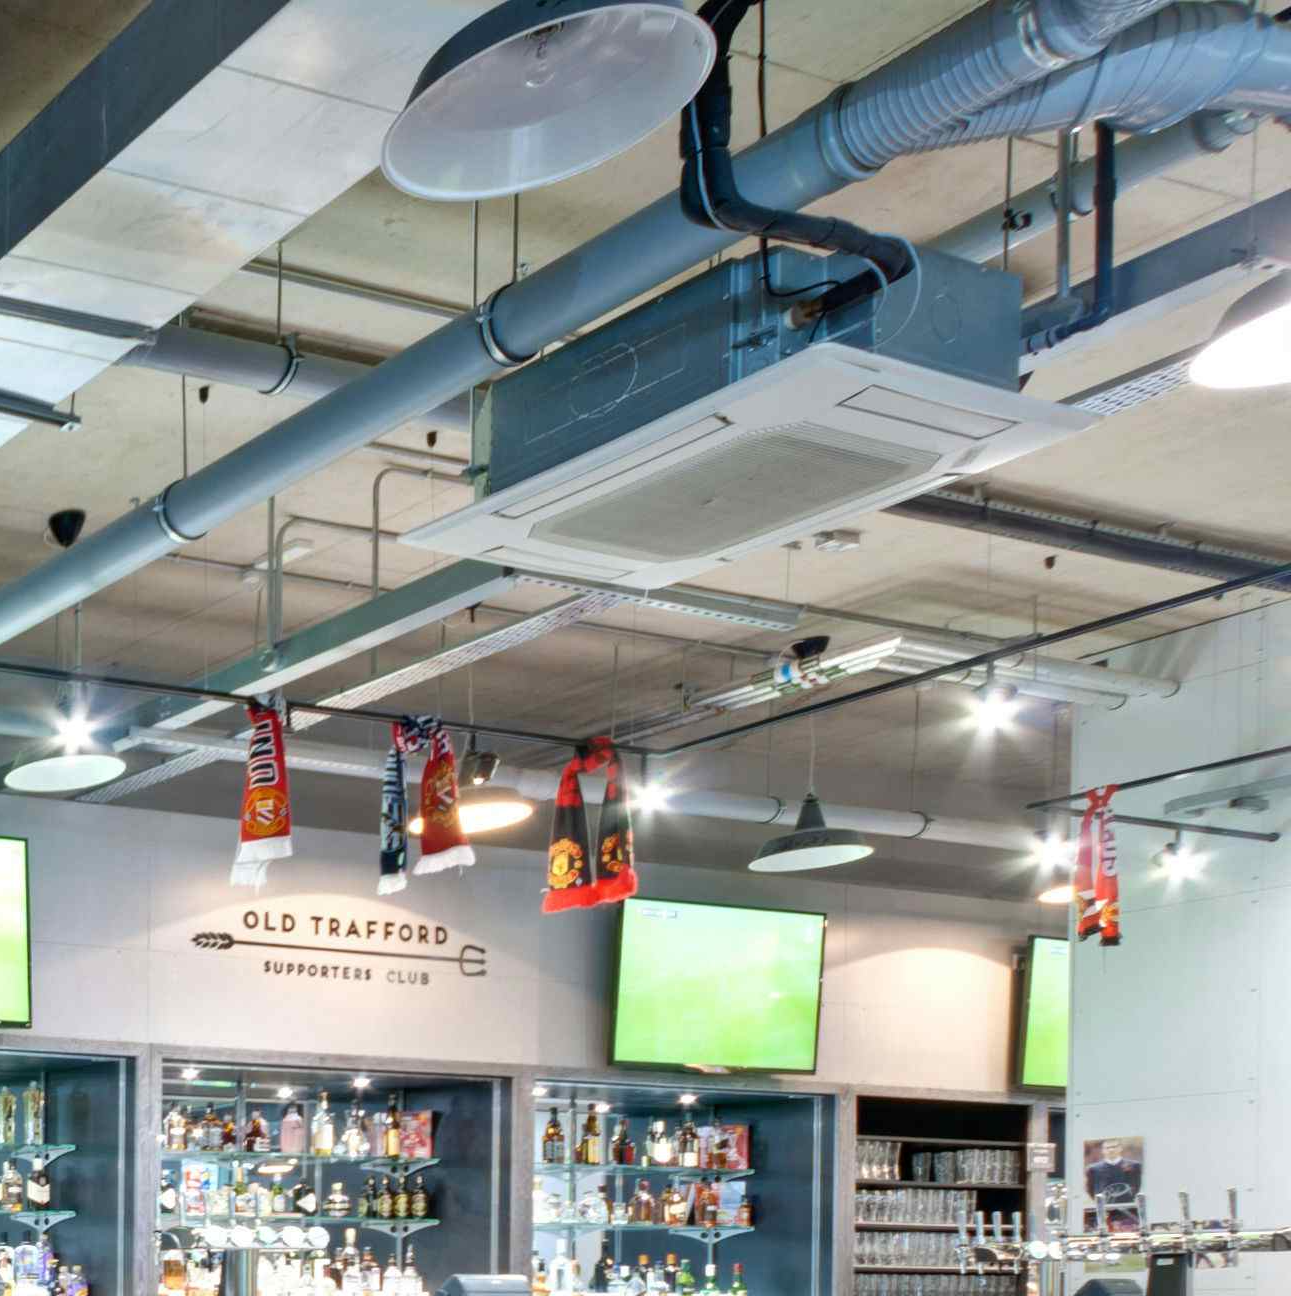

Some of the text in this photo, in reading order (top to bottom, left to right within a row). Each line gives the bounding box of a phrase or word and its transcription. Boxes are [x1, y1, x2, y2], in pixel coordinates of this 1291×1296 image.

[243, 910, 448, 945] OLD TRAFFORD
[264, 960, 430, 985] SUPPORTERS CLUB
